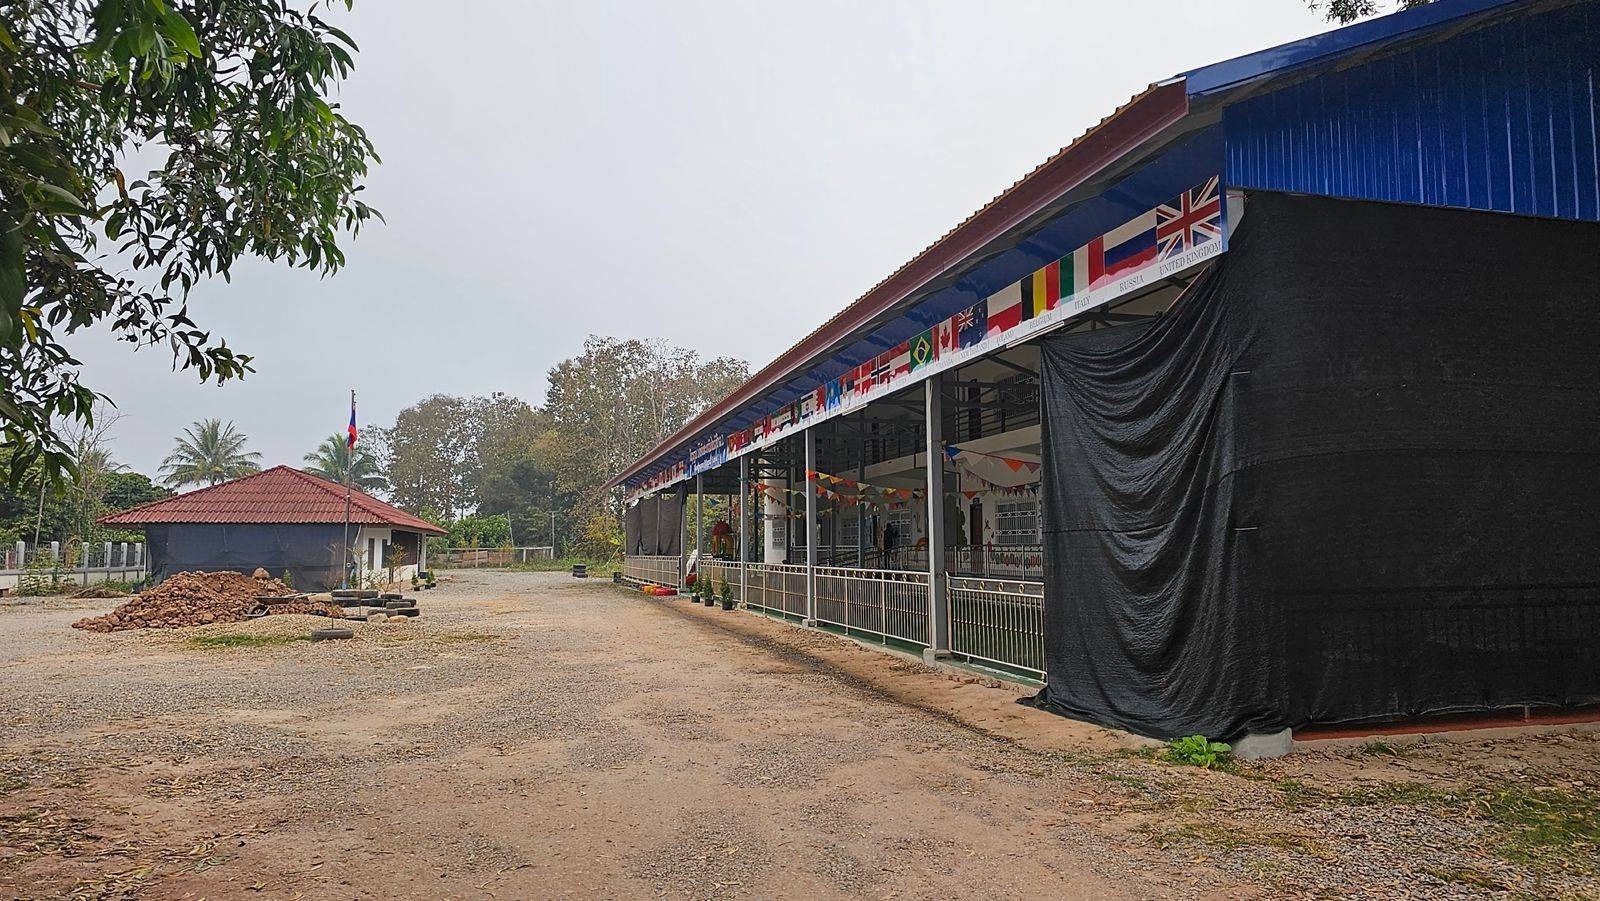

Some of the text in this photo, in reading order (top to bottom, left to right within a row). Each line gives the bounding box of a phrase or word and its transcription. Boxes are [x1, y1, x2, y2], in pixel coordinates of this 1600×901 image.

[1159, 240, 1221, 276] UNITED KINGDOM
[1119, 274, 1144, 292] RUSSIA
[1073, 295, 1091, 310] ITALY
[1029, 312, 1052, 330] BELGIUM
